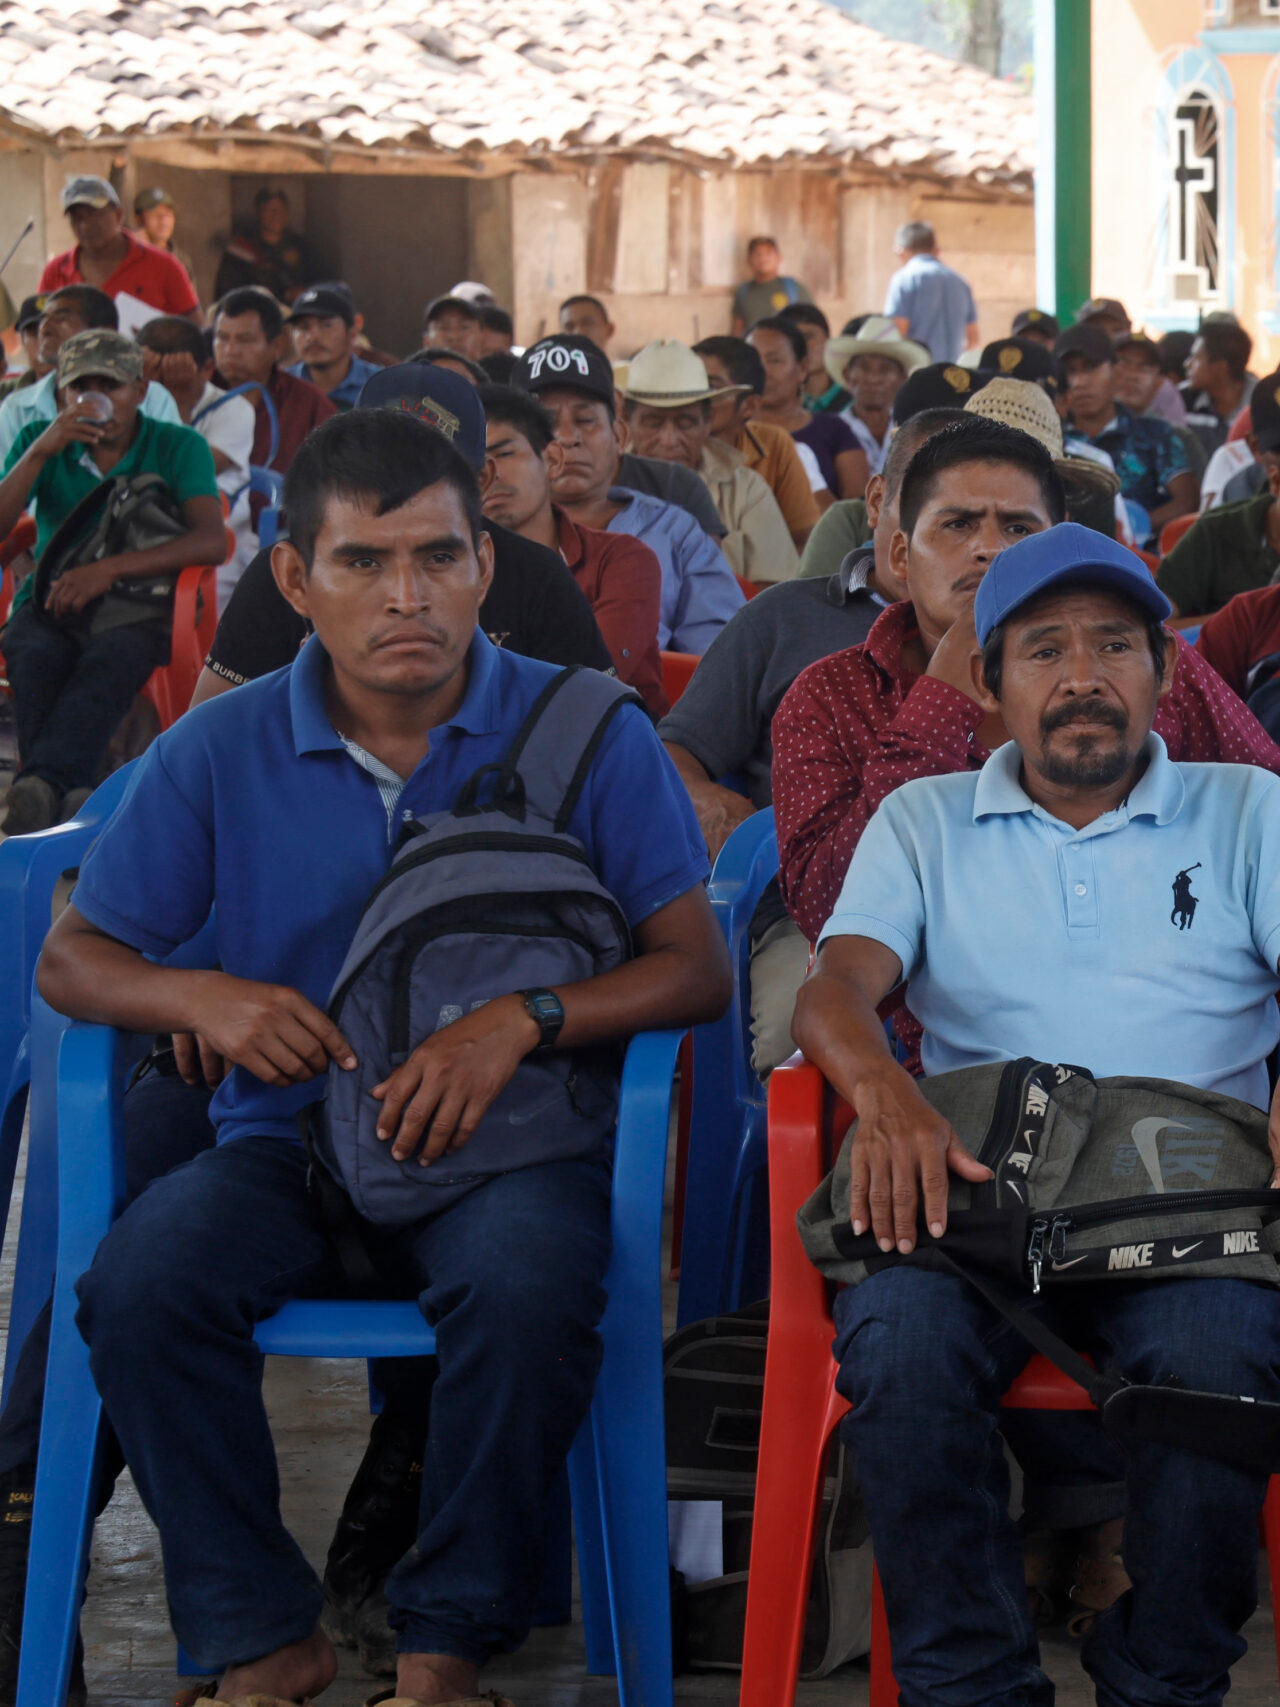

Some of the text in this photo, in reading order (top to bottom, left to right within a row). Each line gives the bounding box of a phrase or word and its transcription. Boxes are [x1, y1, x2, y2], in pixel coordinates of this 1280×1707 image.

[527, 346, 589, 379] 701
[1107, 1231, 1260, 1272] NIKE NIKE
